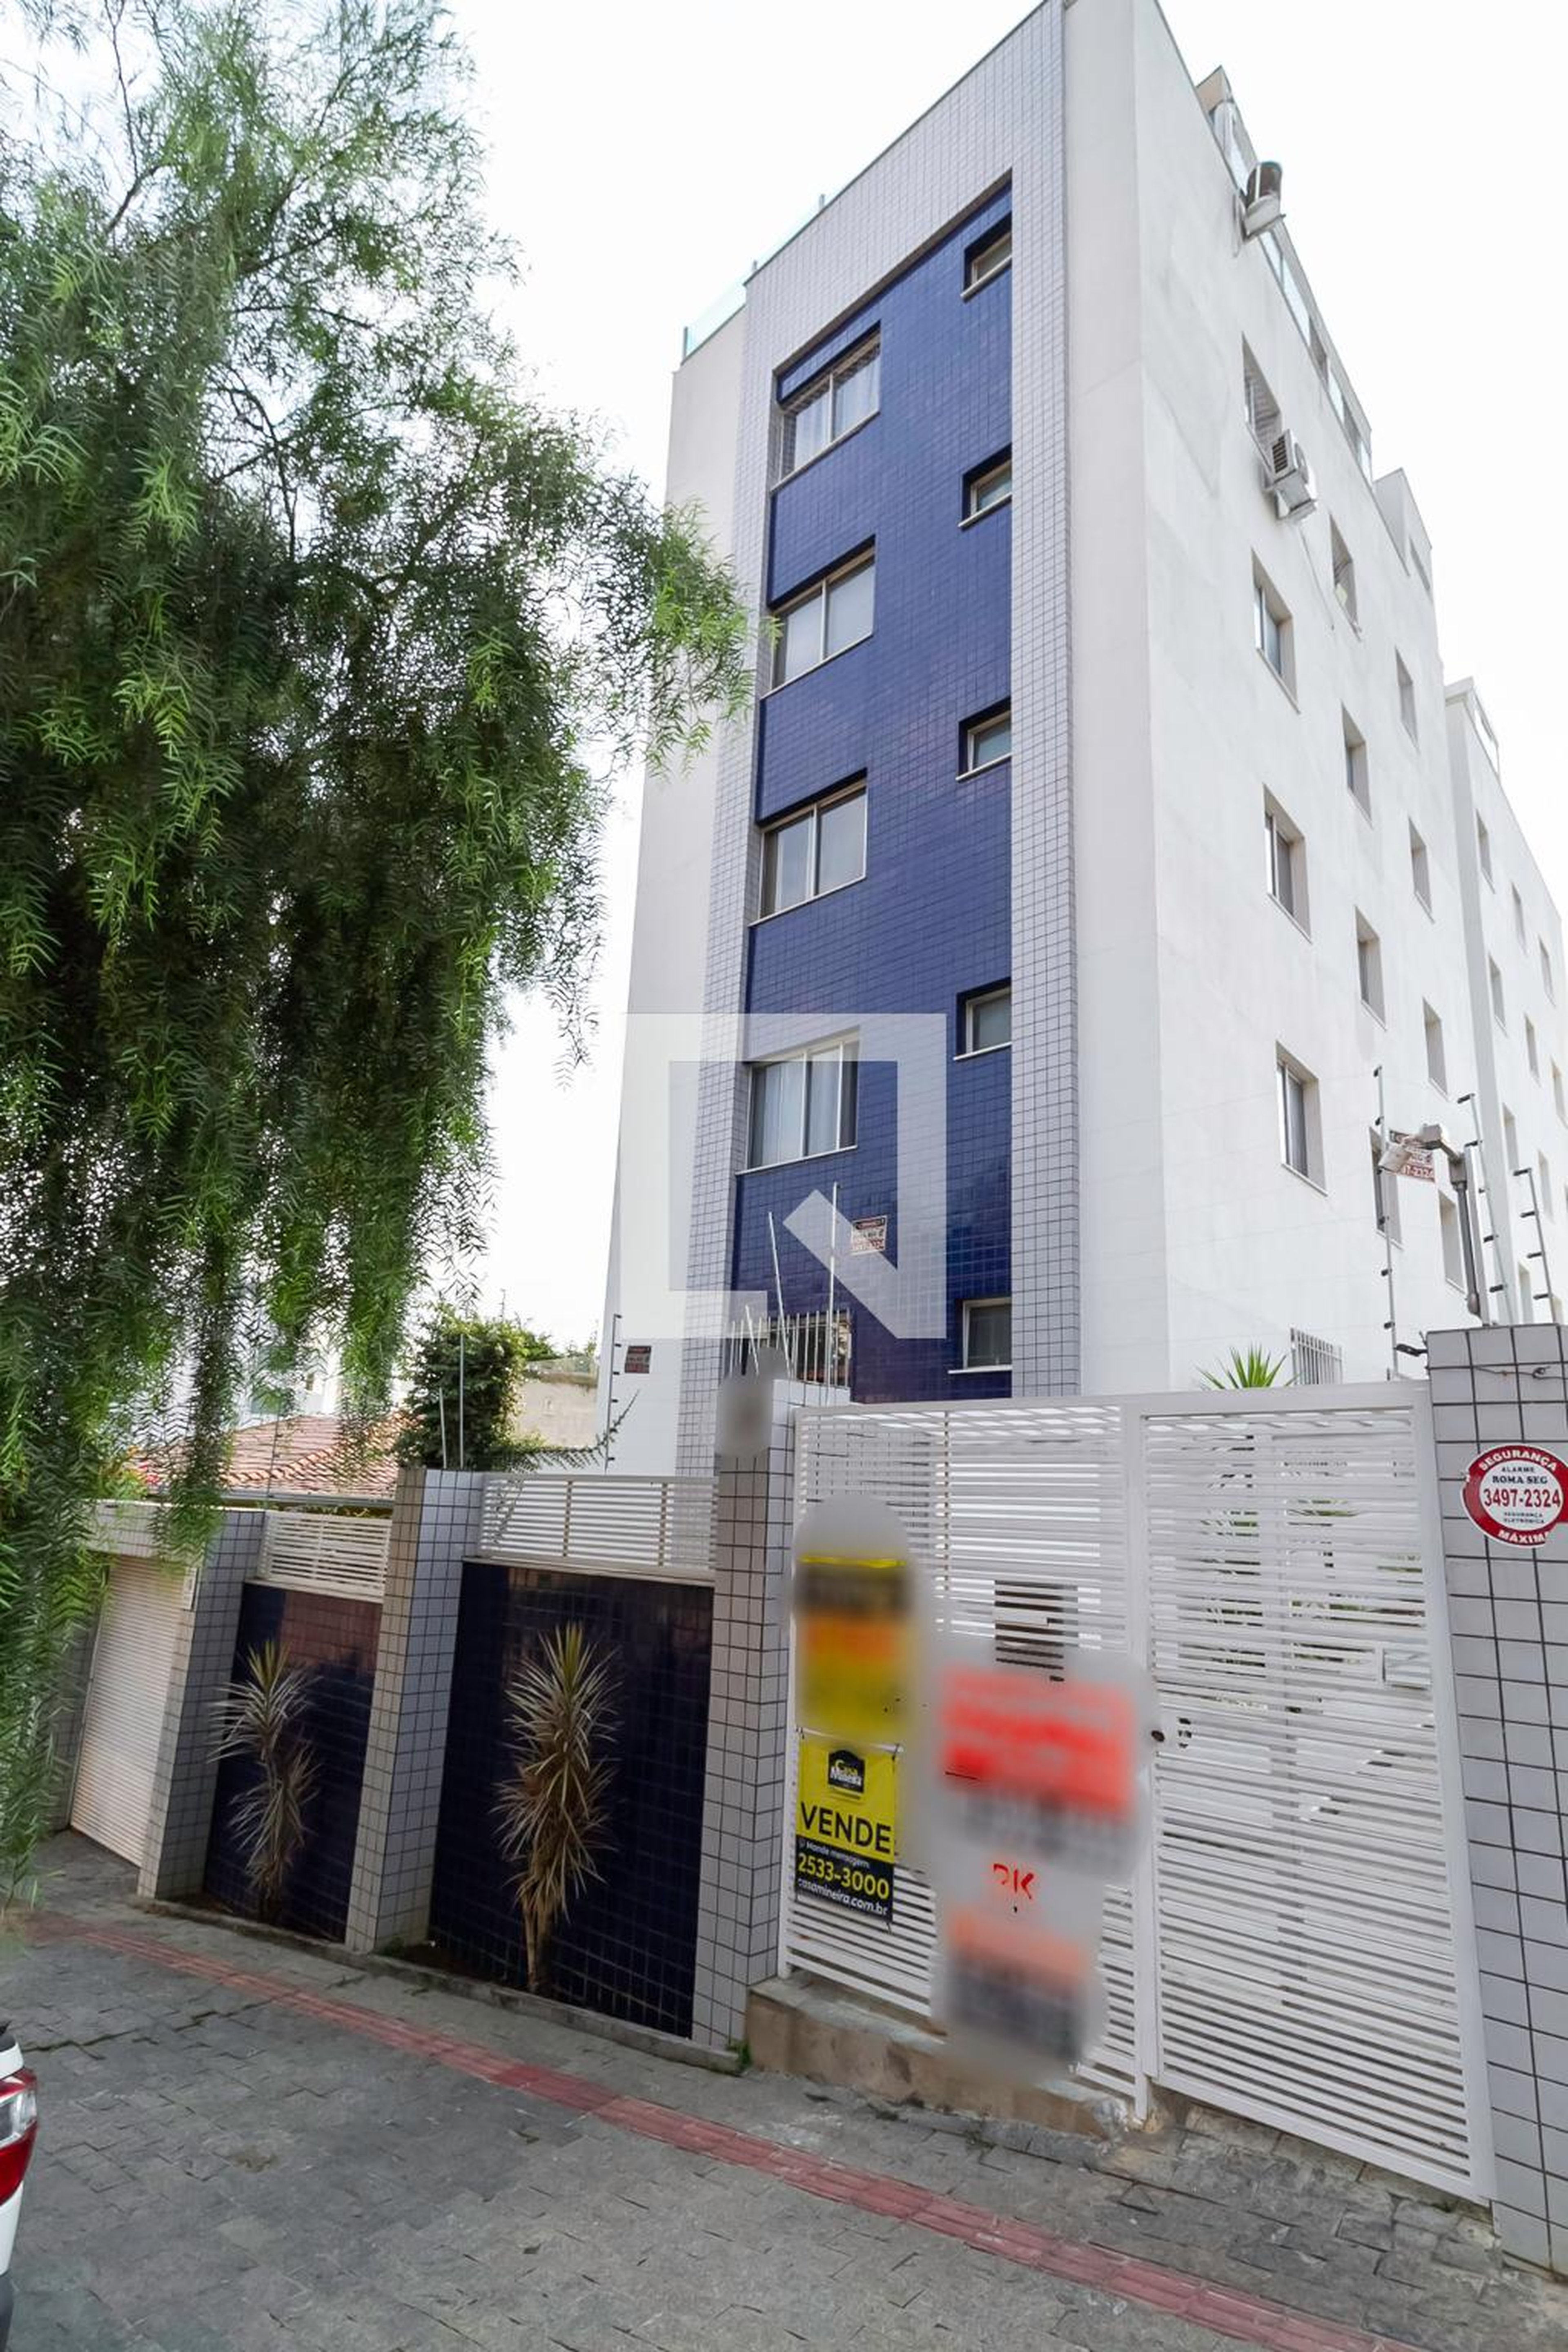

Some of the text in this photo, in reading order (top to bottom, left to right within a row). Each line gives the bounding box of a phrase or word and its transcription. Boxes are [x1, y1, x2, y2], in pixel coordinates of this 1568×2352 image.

[1478, 1450, 1557, 1471] SEGURANÇA
[1492, 1476, 1548, 1484] ROMA SEG
[1483, 1488, 1561, 1507] 3497-2324
[801, 1801, 891, 1853] VENDE
[798, 1853, 889, 1900] 2533-3000
[798, 1878, 889, 1915] casamineira.com.br
